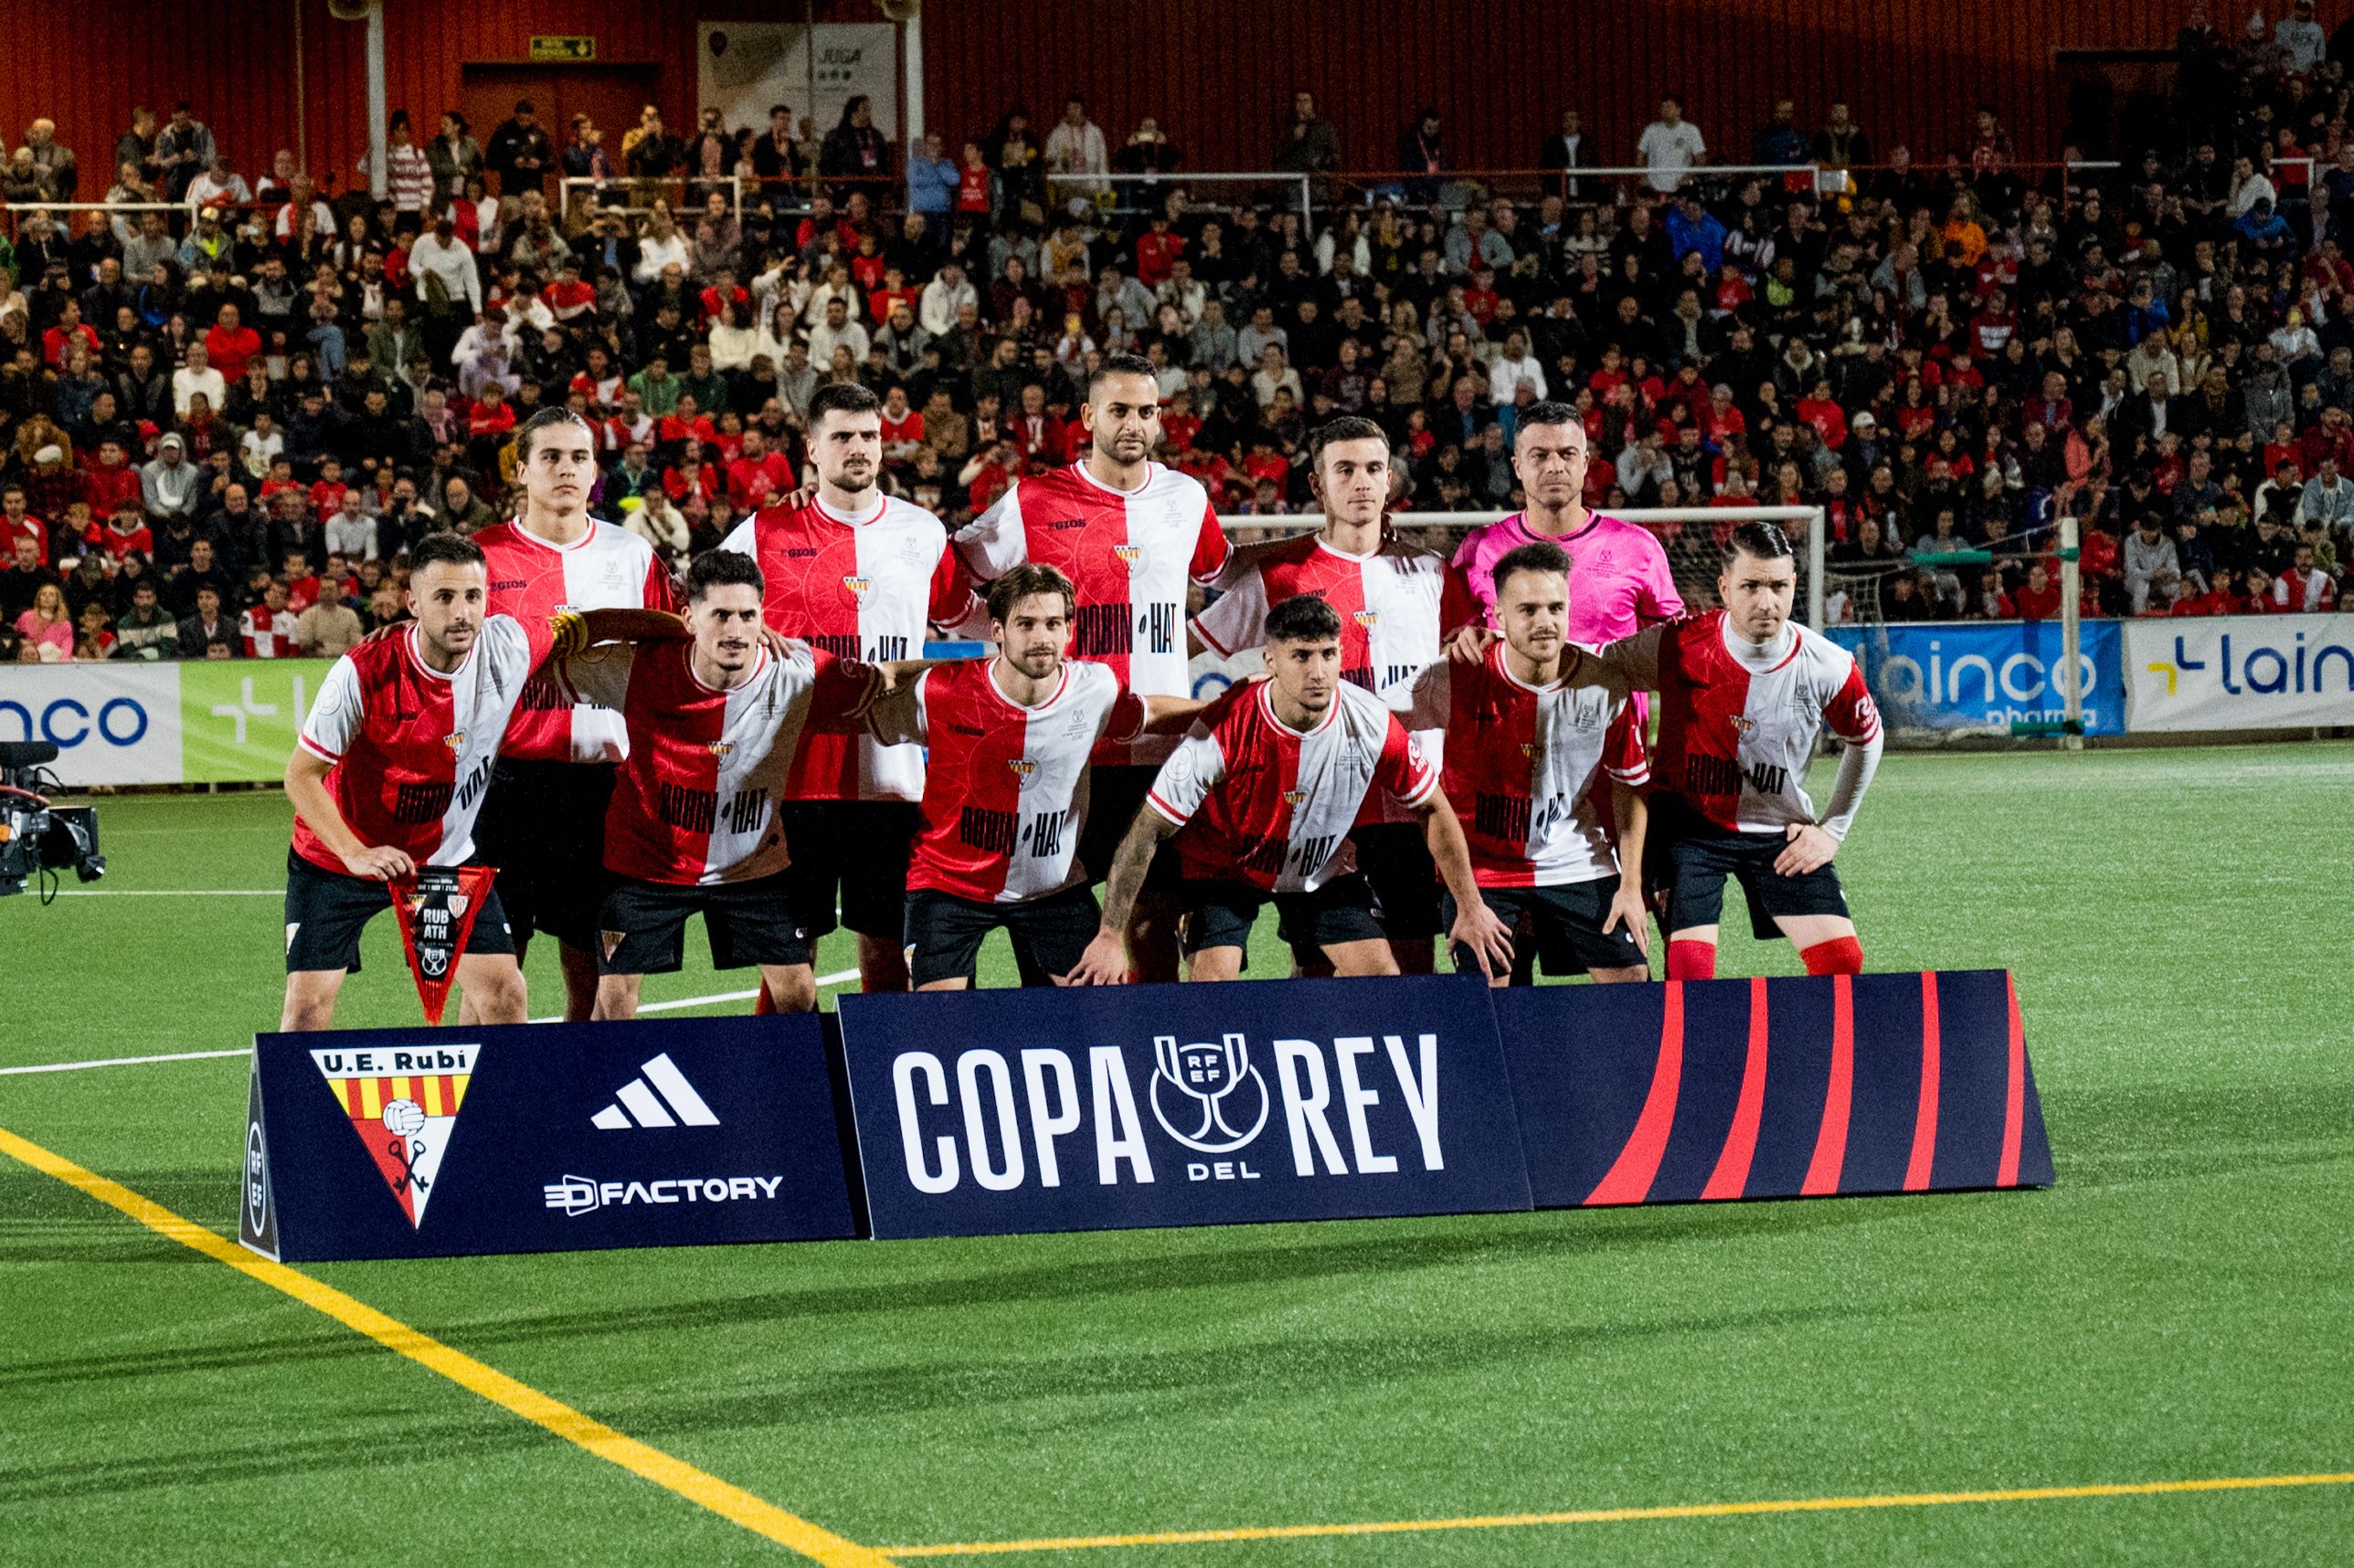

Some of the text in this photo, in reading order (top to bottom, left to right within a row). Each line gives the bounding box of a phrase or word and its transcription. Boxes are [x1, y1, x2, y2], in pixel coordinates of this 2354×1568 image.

[1076, 602, 1177, 656] ROBIN HAT
[2221, 631, 2354, 694] lain
[730, 787, 769, 834] HAT
[960, 805, 1067, 857] ROBIN HAT
[423, 908, 450, 925] RUB
[423, 924, 448, 939] ATH
[323, 1049, 467, 1074] U.E. Rubí
[1187, 1054, 1218, 1068] RF
[1190, 1069, 1221, 1083] EF
[892, 1033, 1445, 1194] COPA REY
[1187, 1160, 1261, 1182] DEL
